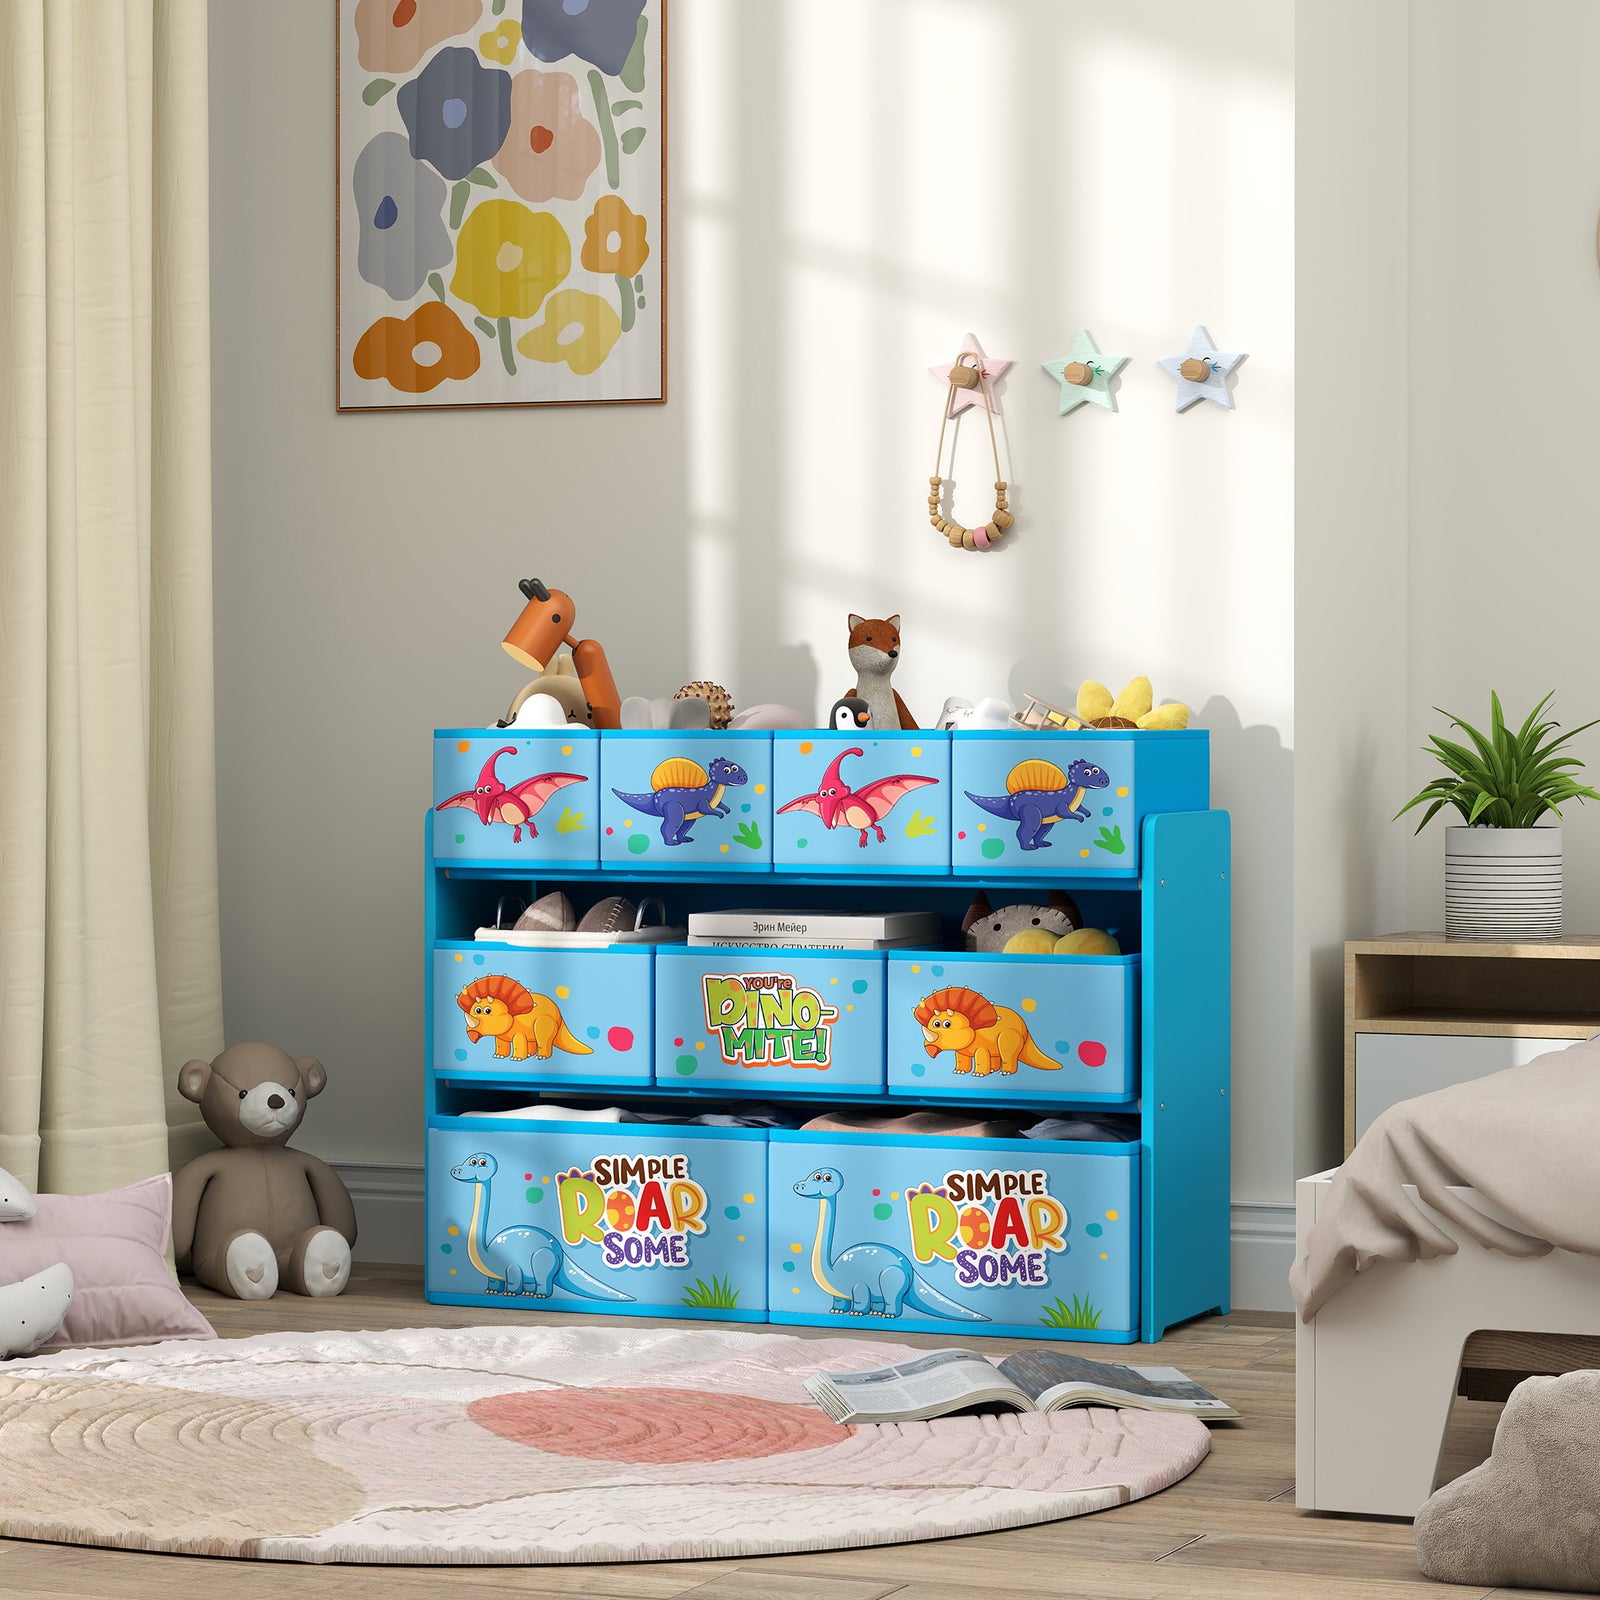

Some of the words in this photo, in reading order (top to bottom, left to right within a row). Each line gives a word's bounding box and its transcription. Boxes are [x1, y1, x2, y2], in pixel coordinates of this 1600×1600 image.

[752, 921, 775, 934] Эрин
[777, 922, 808, 935] Мейер
[743, 976, 793, 990] YOU're
[705, 977, 835, 1031] DINO-
[720, 1025, 828, 1063] MITE!
[594, 1157, 686, 1186] SIMPLE
[946, 1172, 1045, 1202] SIMPLE
[559, 1175, 704, 1244] ROAR
[909, 1191, 1064, 1262] ROAR
[603, 1231, 687, 1265] SOME
[956, 1249, 1045, 1284] SOME
